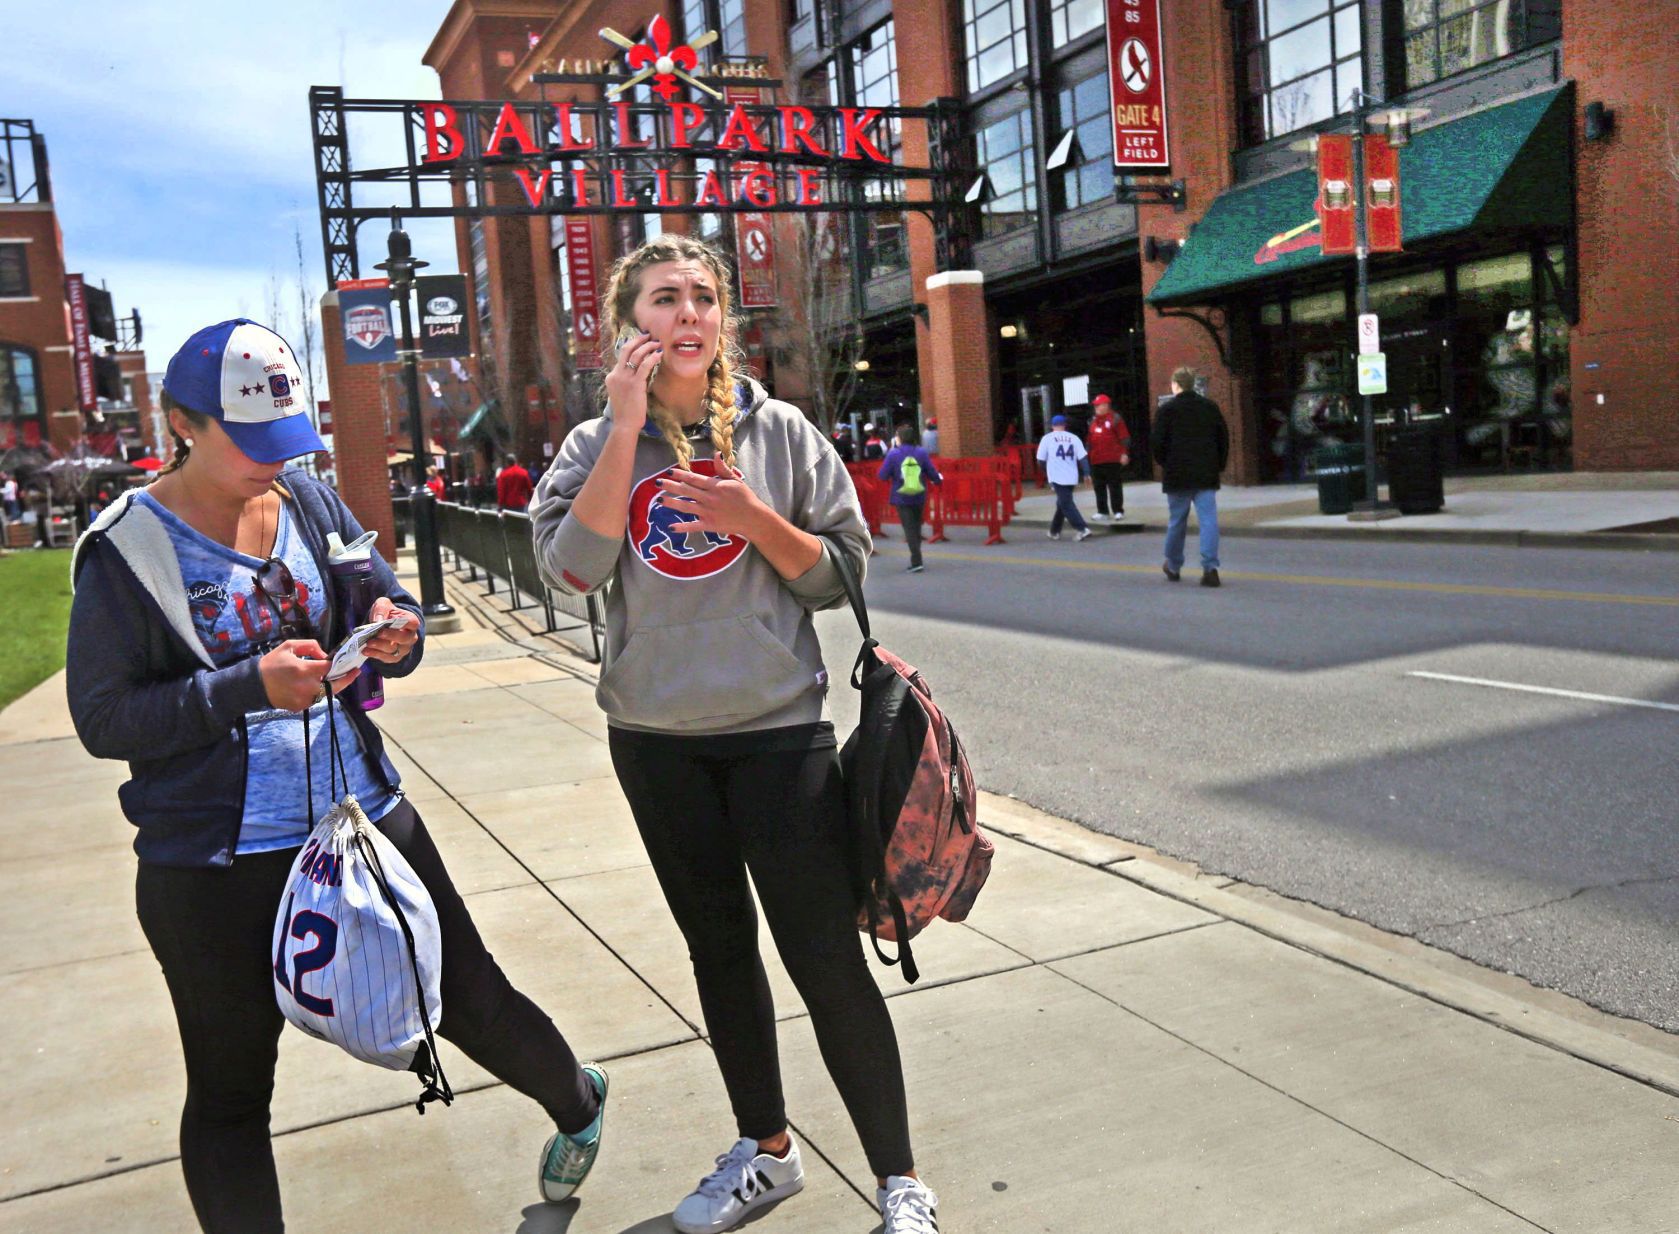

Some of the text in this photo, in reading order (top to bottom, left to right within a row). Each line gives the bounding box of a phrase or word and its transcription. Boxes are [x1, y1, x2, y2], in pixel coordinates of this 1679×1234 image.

[1125, 11, 1140, 23] 85
[1117, 104, 1160, 126] GATE 4
[417, 101, 892, 163] BALLPARK
[1126, 137, 1154, 147] LEFT
[1124, 149, 1158, 159] FIELD
[514, 168, 821, 208] VILLAGE
[423, 314, 463, 325] MIDWEST
[429, 324, 459, 337] Live!
[274, 397, 293, 408] CUBS
[1055, 444, 1075, 461] 44
[185, 581, 231, 600] hicago
